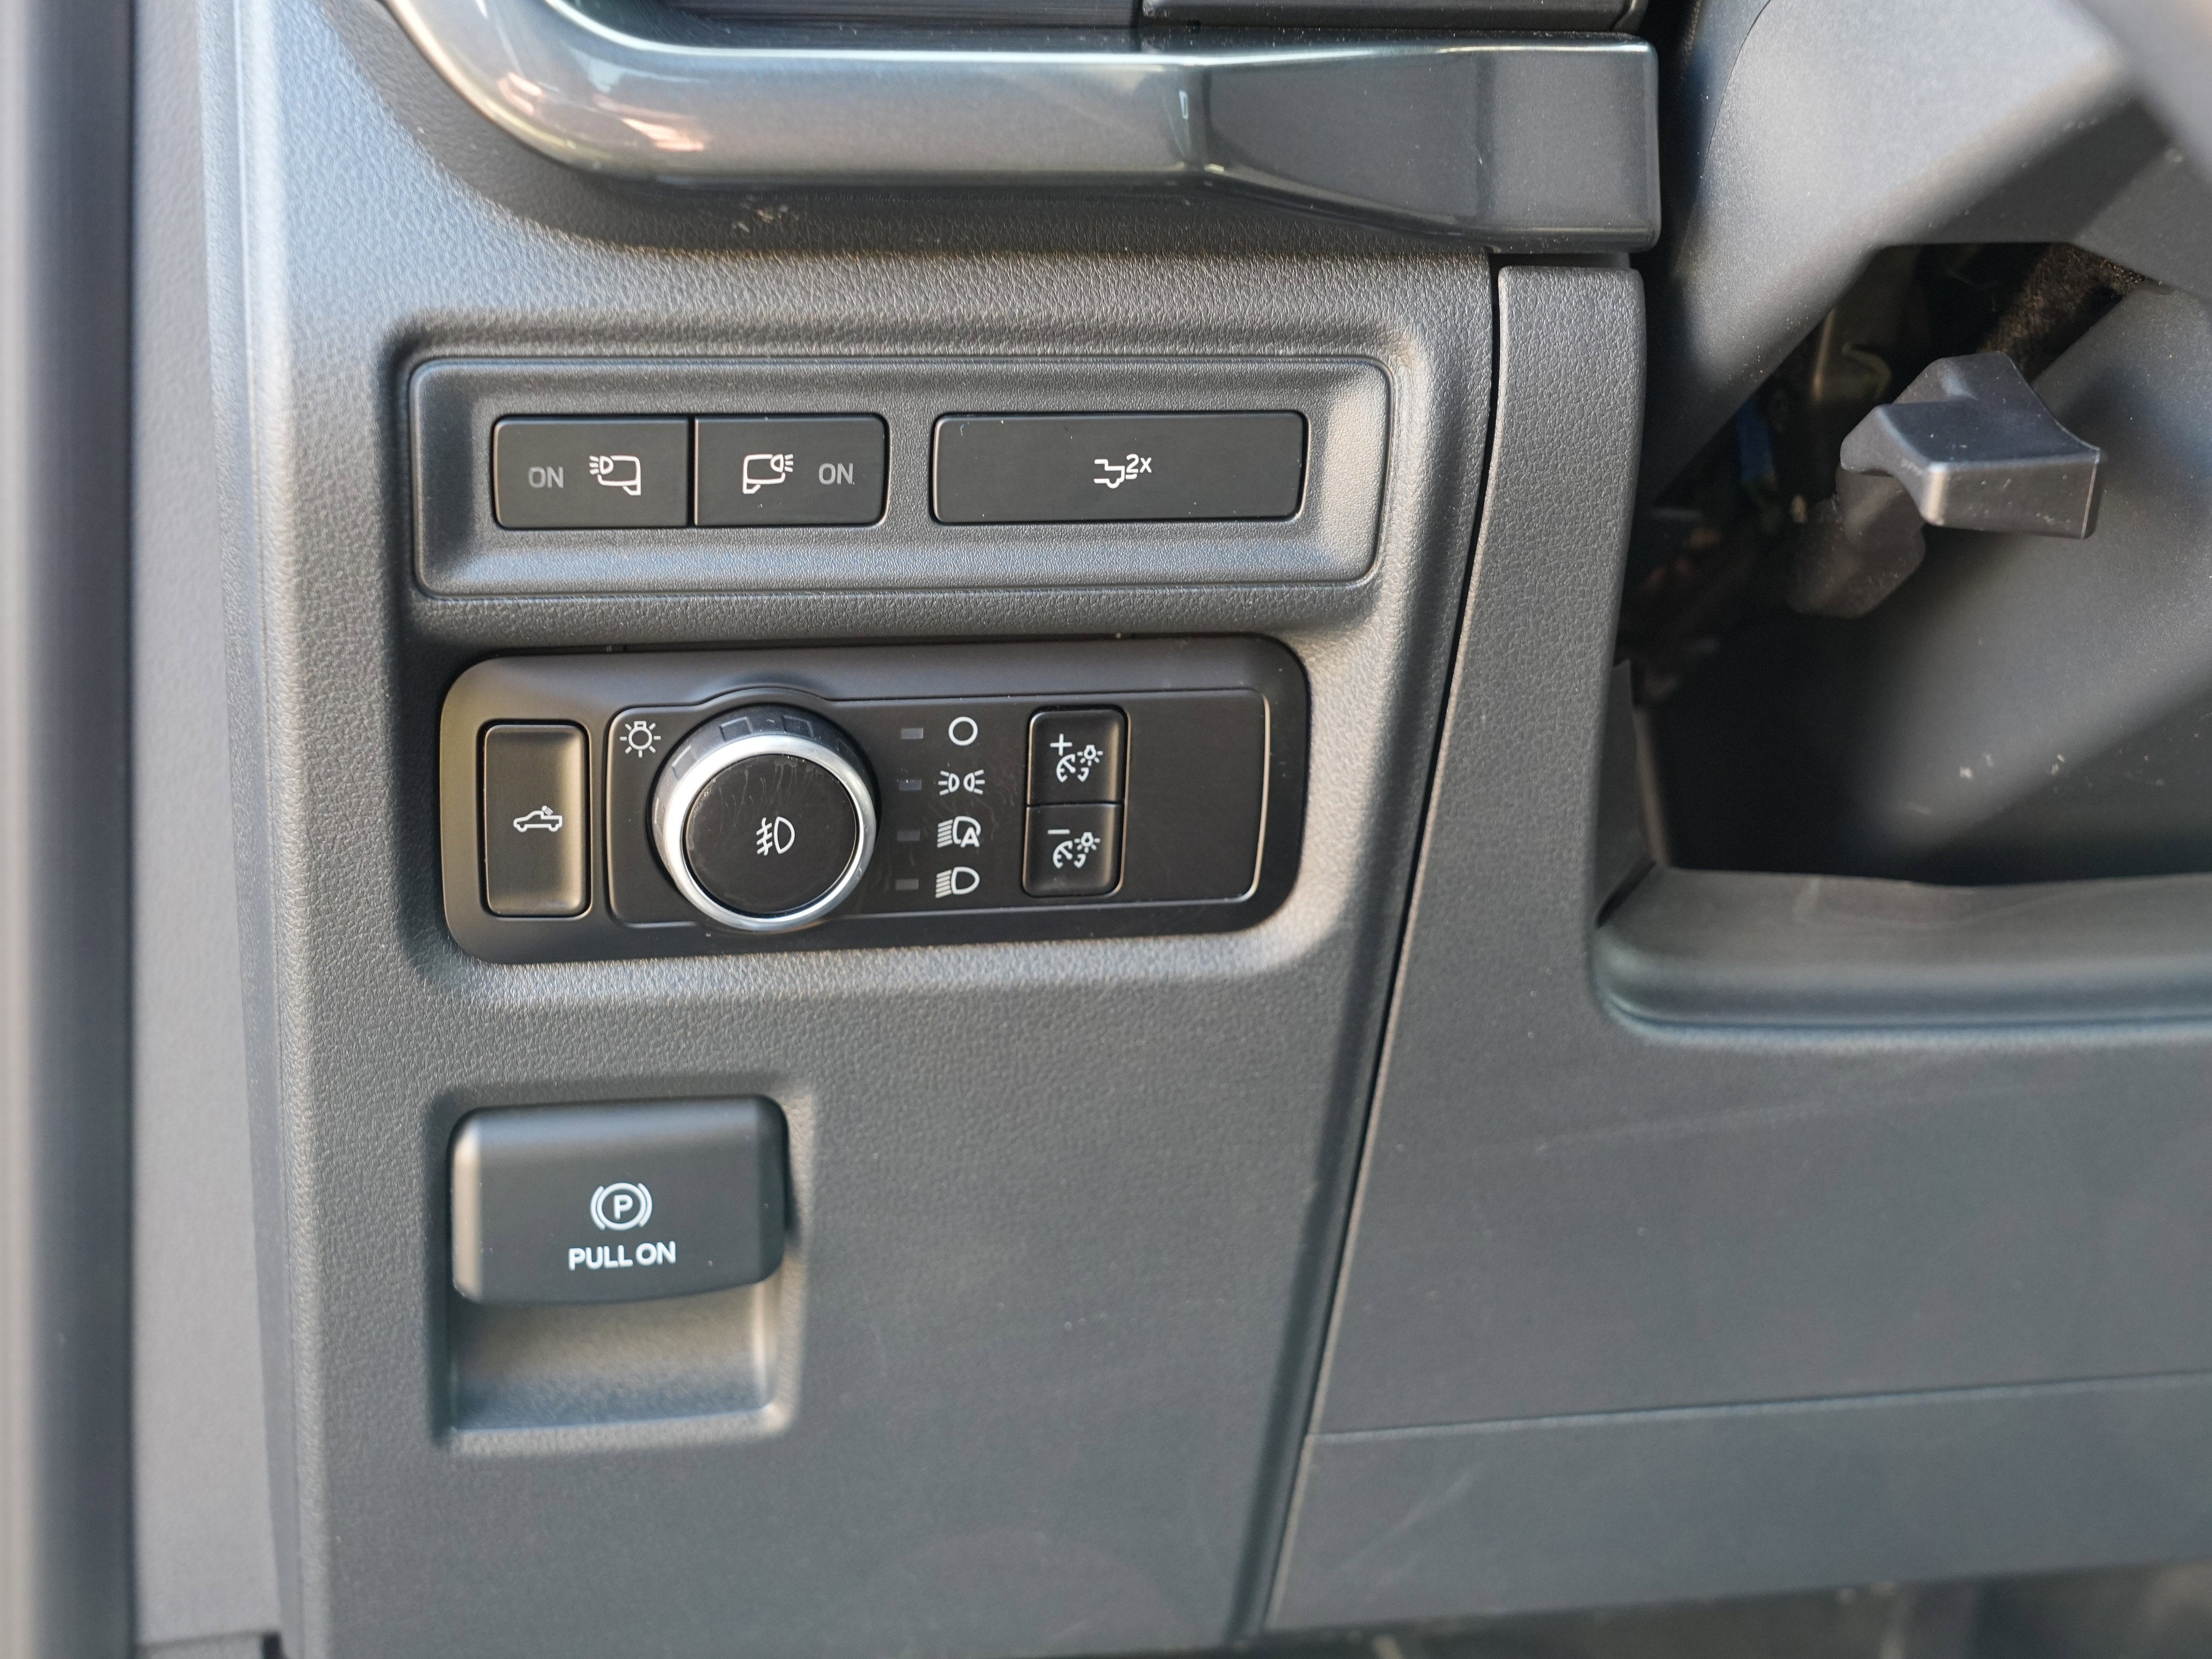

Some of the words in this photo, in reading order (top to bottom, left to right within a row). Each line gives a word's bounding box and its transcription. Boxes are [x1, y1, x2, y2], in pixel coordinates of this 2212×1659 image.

[528, 466, 564, 488] ON
[818, 462, 853, 485] ON
[960, 827, 981, 848] A
[612, 1194, 633, 1220] P
[568, 1244, 633, 1270] PULL
[636, 1240, 676, 1264] ON
